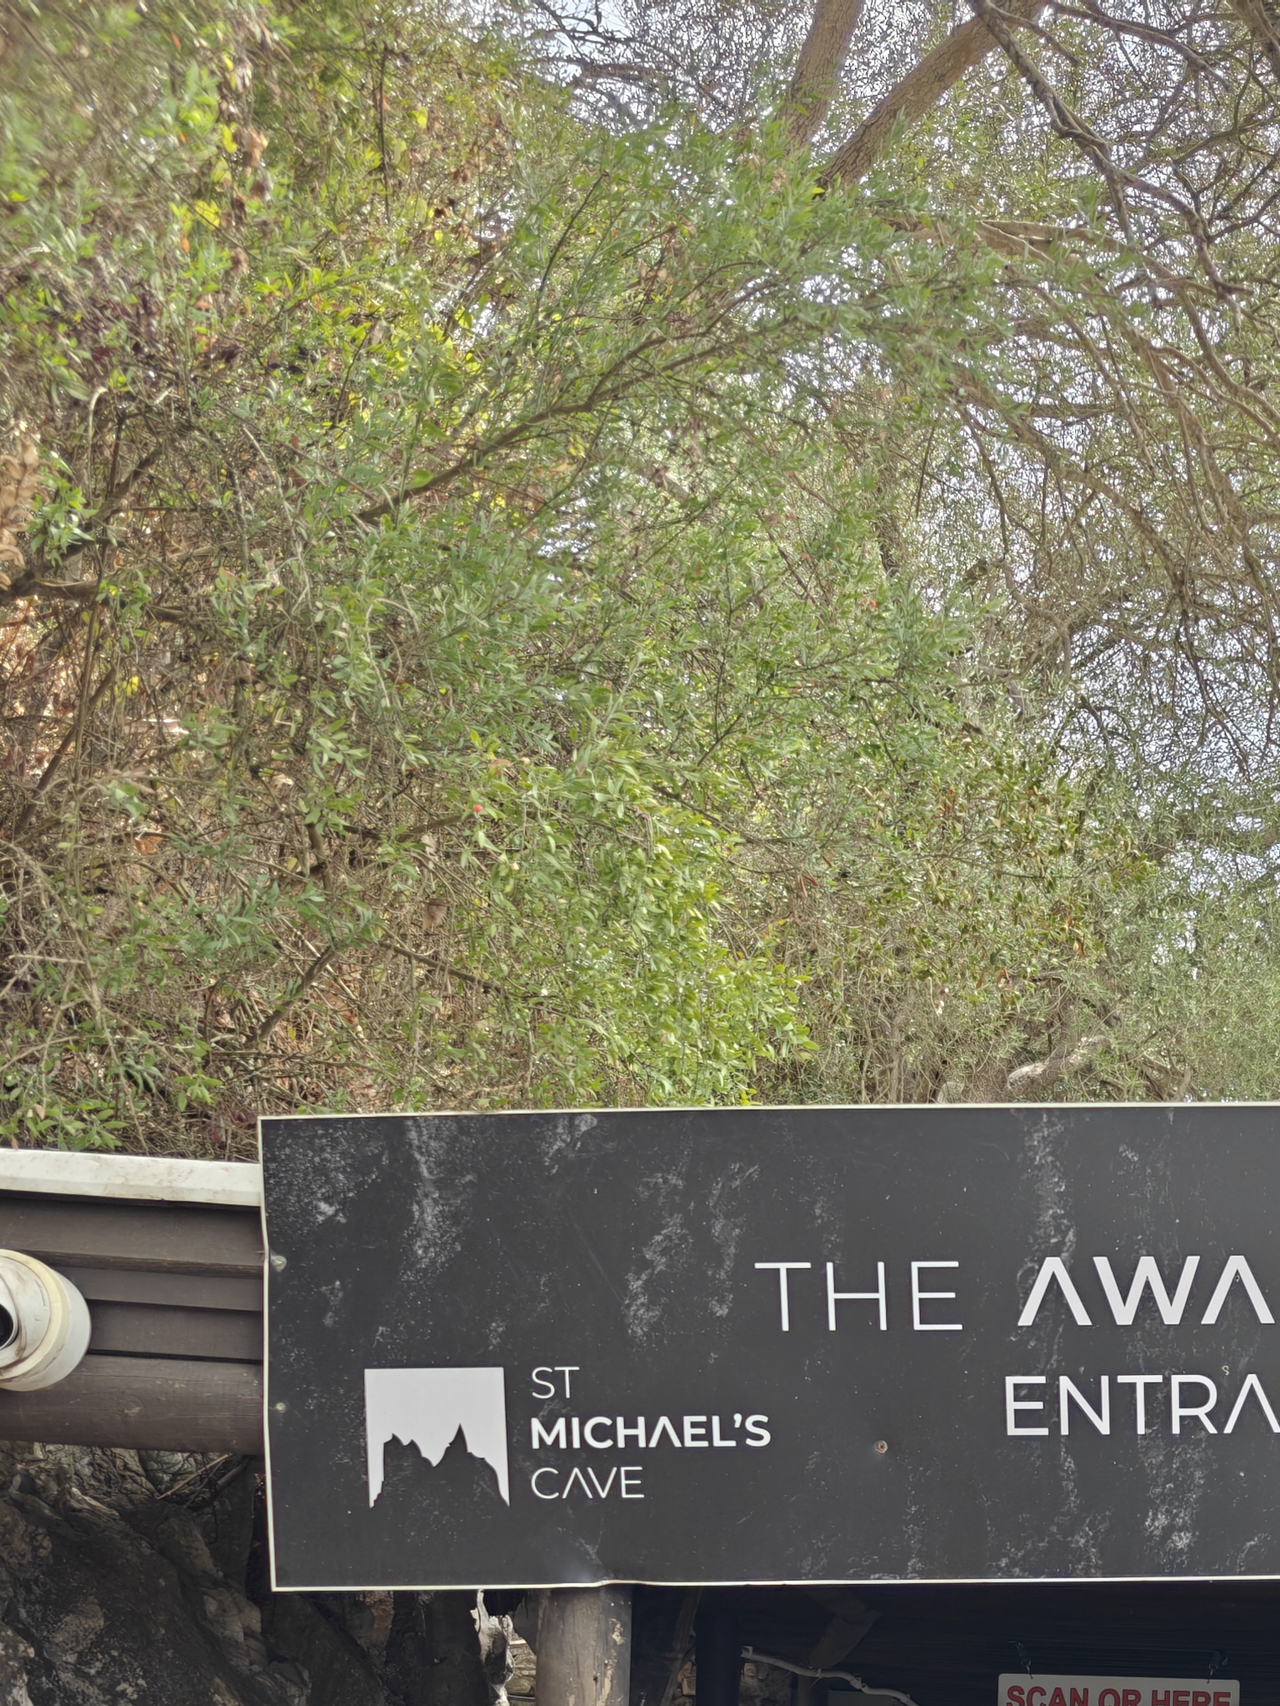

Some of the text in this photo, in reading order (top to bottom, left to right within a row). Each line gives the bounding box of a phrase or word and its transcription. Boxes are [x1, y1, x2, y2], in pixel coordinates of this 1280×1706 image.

[755, 1261, 962, 1331] THE
[531, 1366, 580, 1399] ST
[531, 1414, 771, 1450] MICHAEL'S
[531, 1466, 645, 1500] CAVE
